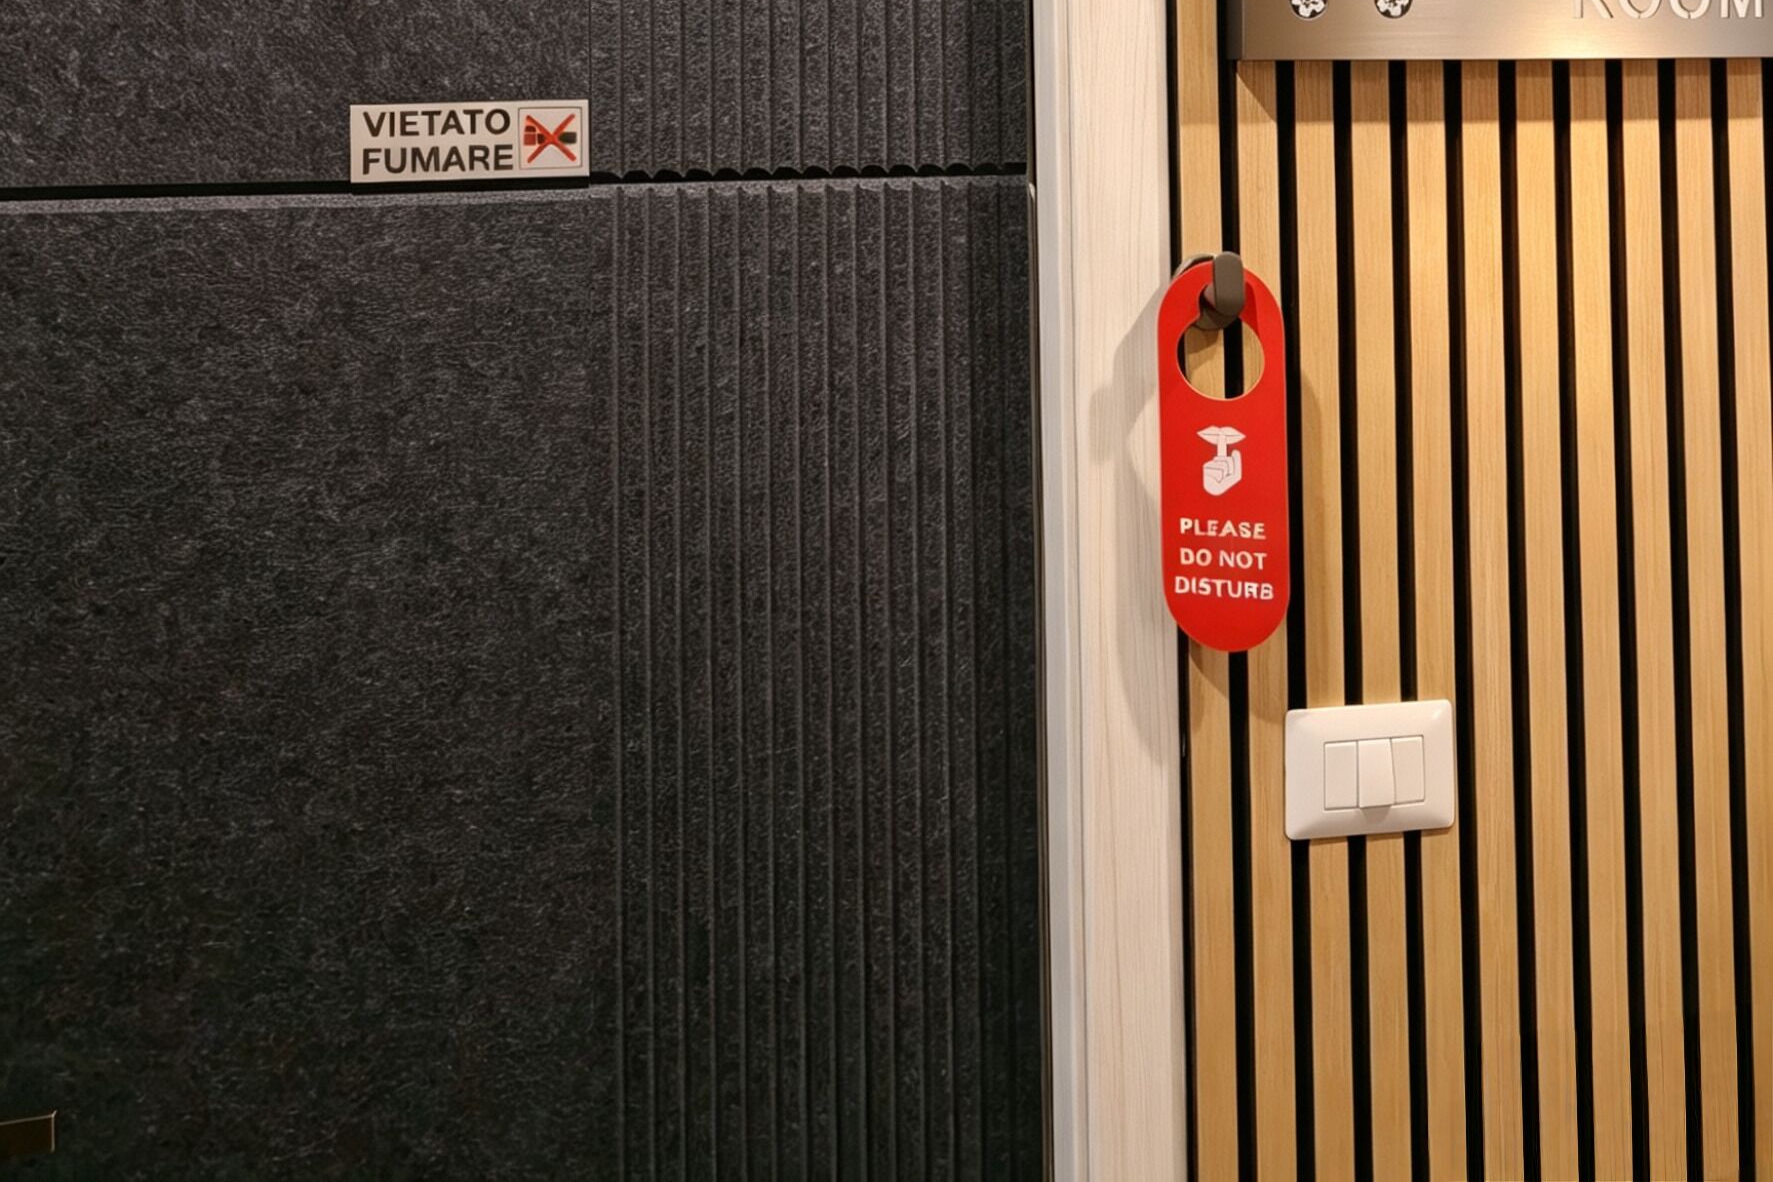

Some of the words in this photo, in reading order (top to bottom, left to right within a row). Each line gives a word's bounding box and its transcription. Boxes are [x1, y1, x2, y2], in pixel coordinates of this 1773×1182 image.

[362, 108, 511, 138] VIETATO
[362, 144, 514, 175] FUMARE
[1180, 517, 1266, 540] PLEASE
[1180, 547, 1212, 566] DO
[1219, 550, 1267, 570] NOT
[1174, 575, 1274, 600] DISTURB
